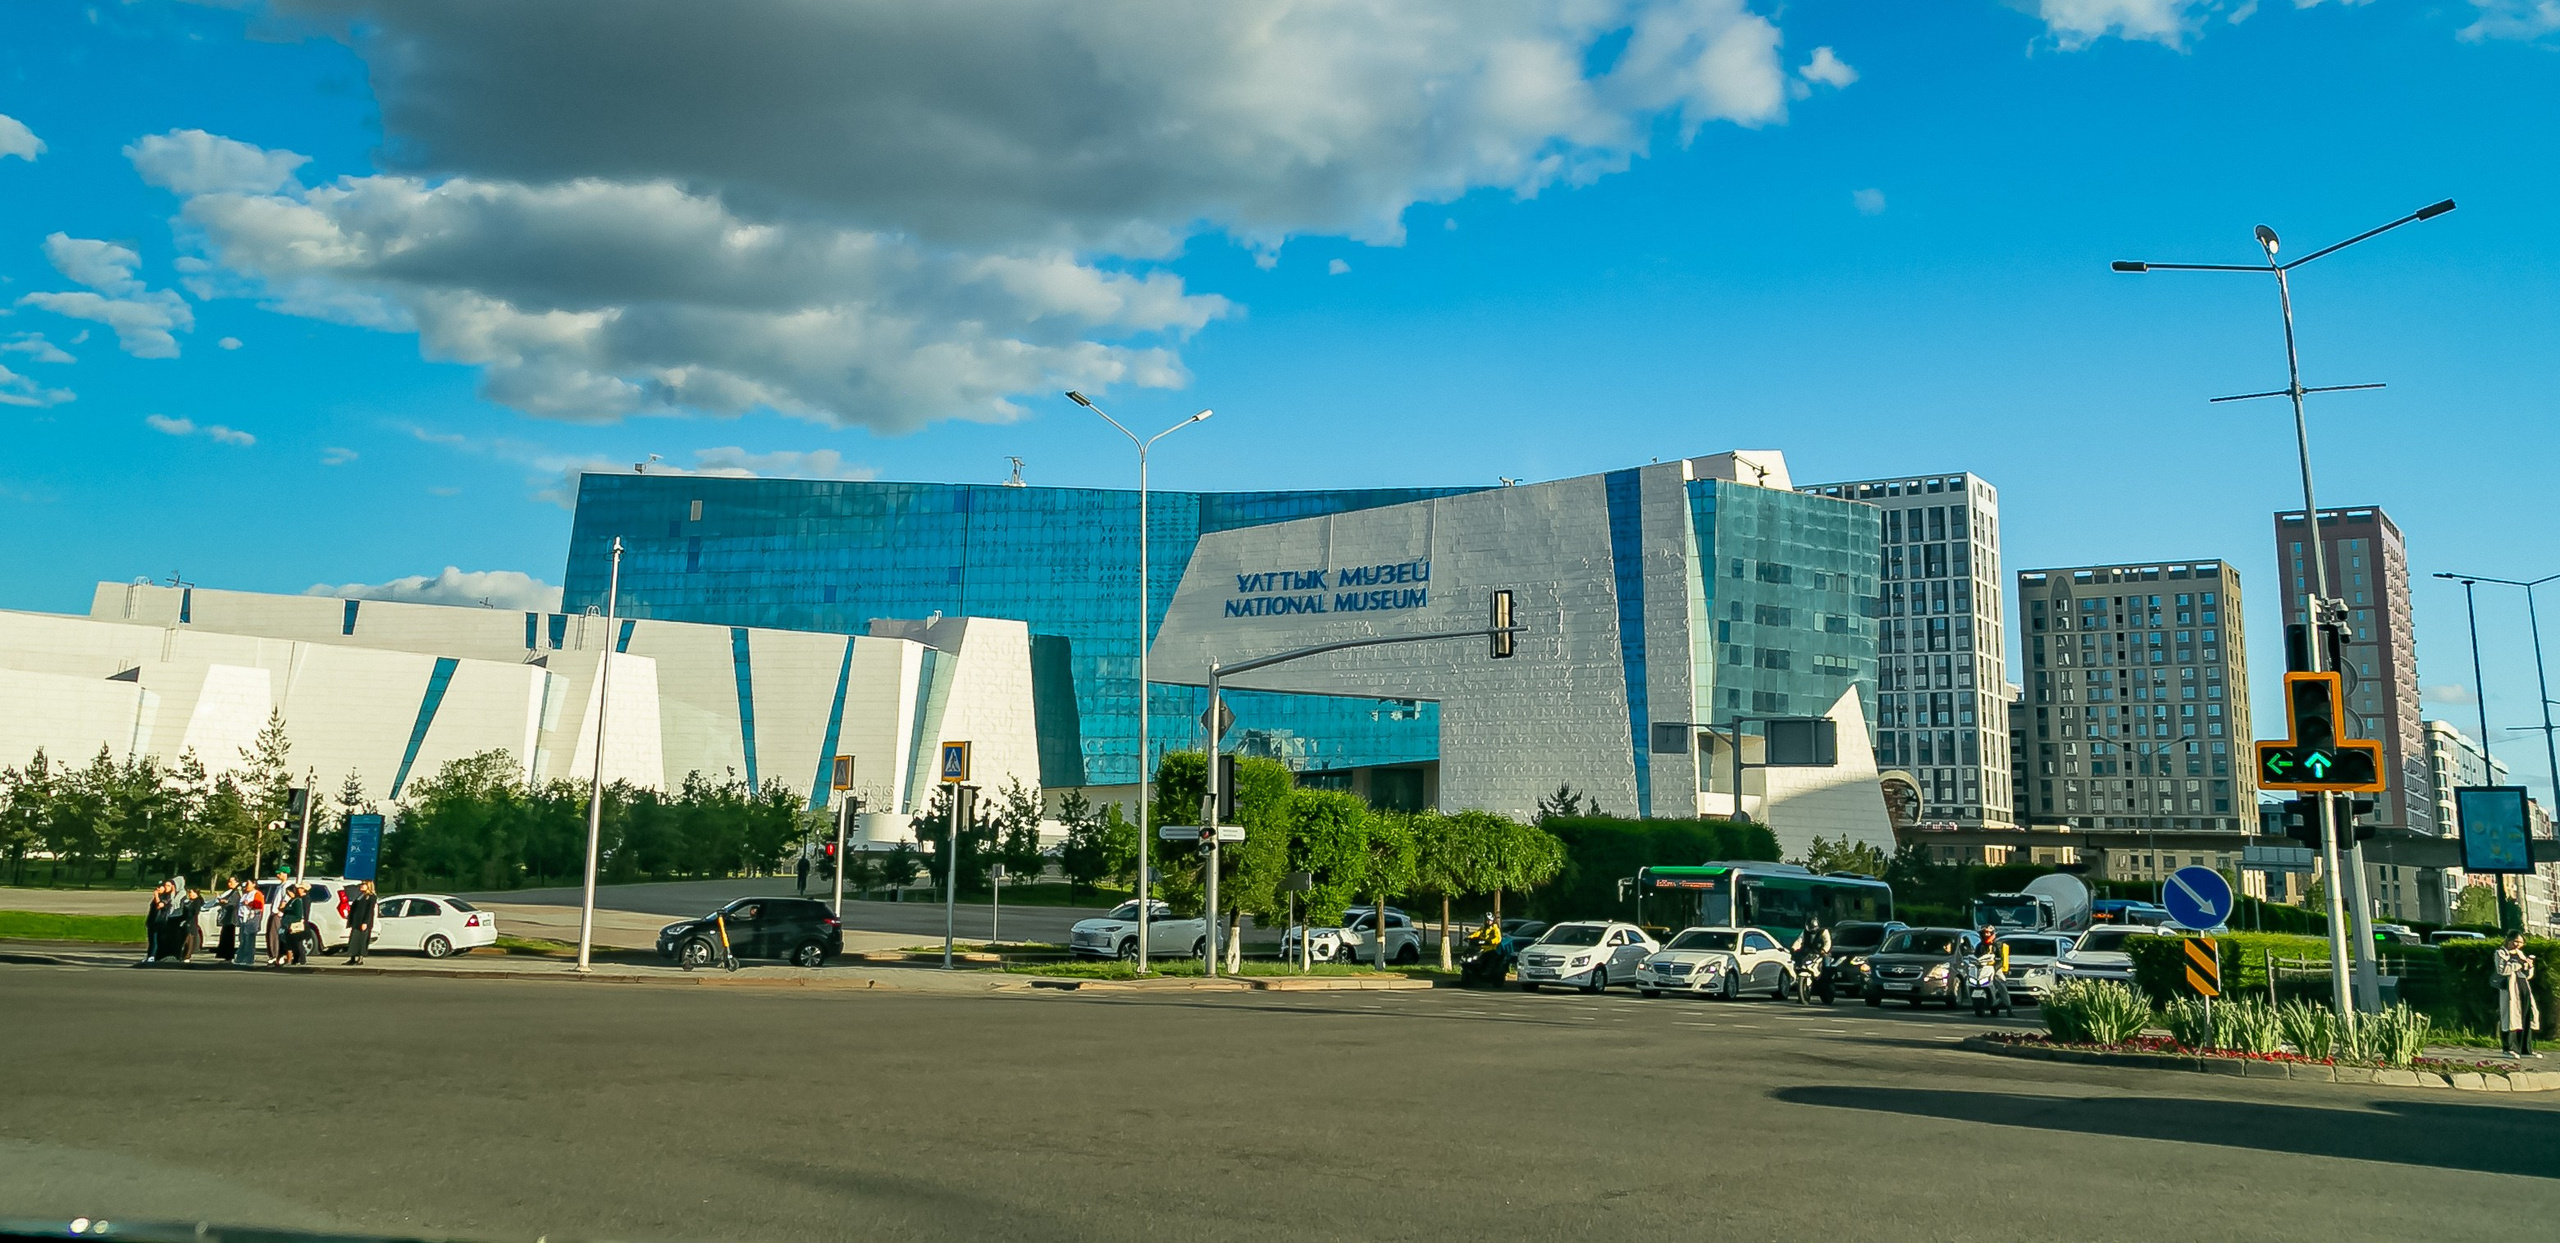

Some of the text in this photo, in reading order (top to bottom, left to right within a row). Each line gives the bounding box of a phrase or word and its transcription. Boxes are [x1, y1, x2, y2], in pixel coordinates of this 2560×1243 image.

[1237, 557, 1430, 593] ҰЛТТЫҚ МУЗЕЙ
[1224, 588, 1428, 618] NATIONAL MUSEUM
